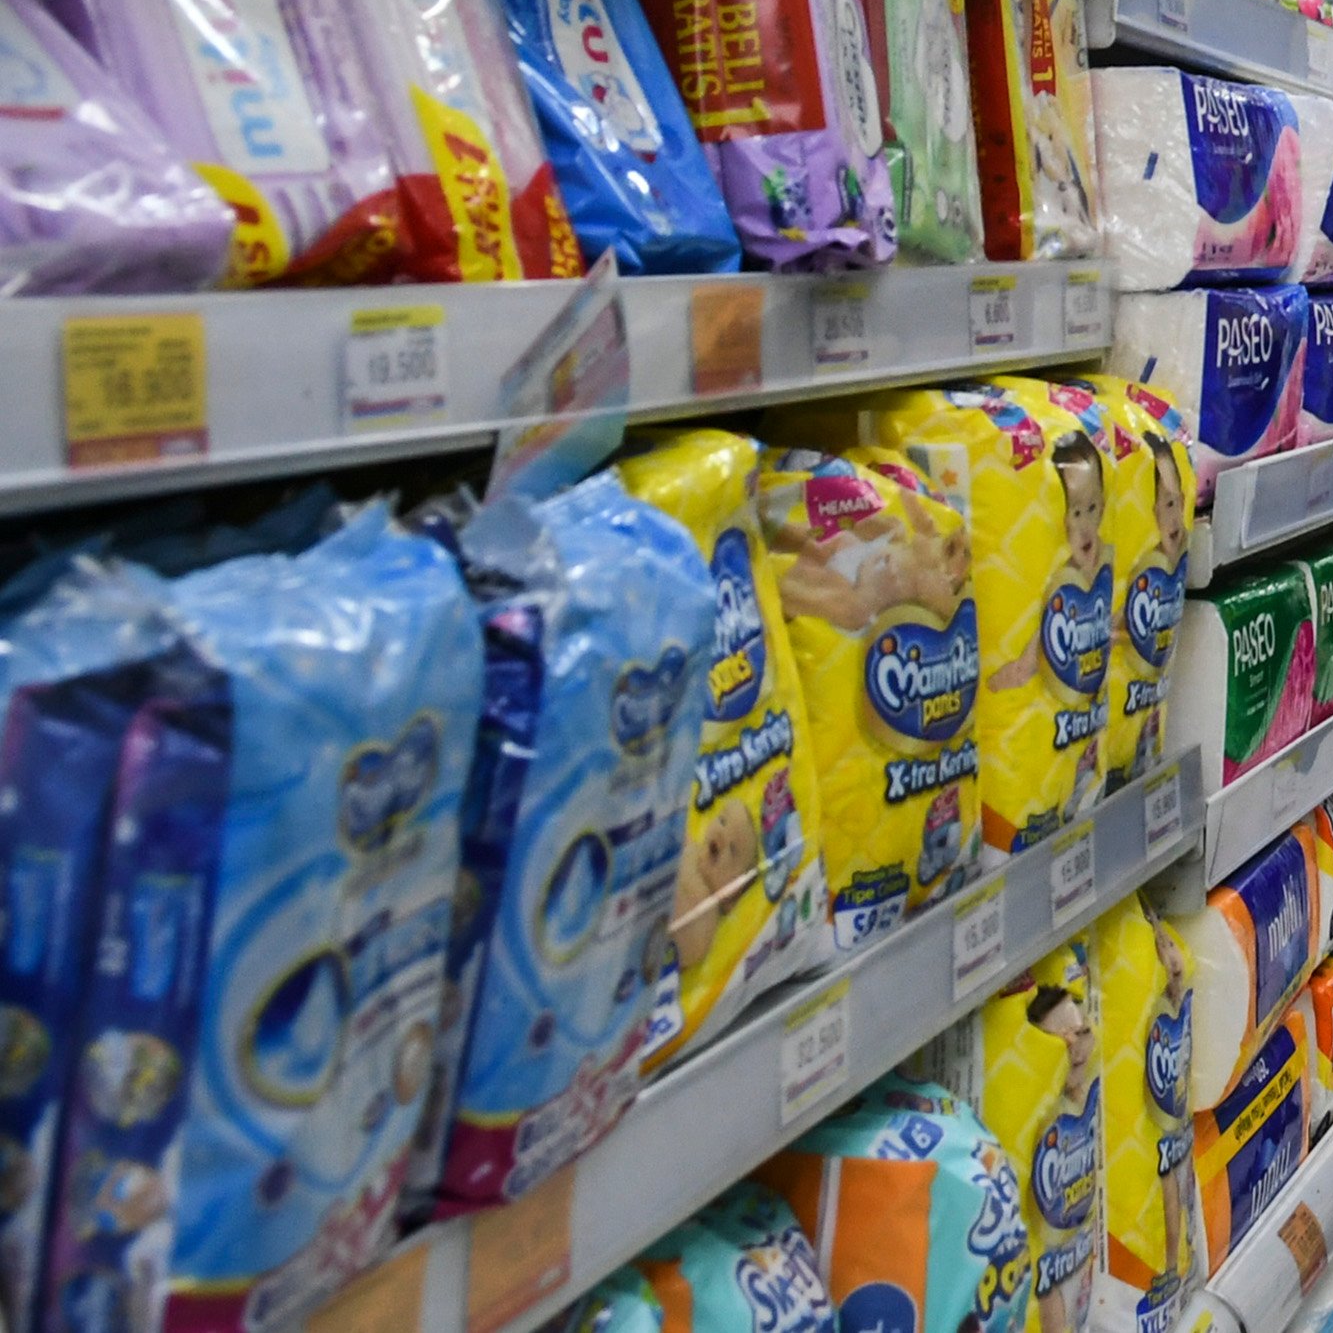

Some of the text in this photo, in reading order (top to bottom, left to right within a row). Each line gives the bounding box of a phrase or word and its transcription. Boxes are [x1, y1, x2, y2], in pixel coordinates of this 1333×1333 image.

[716, 0, 766, 97] BELI
[1194, 86, 1249, 138] PASEO
[1216, 315, 1274, 369] PASEO
[1233, 612, 1276, 678] PASEO
[922, 691, 962, 727] pants
[886, 758, 938, 803] X-tra
[1267, 886, 1304, 962] multi
